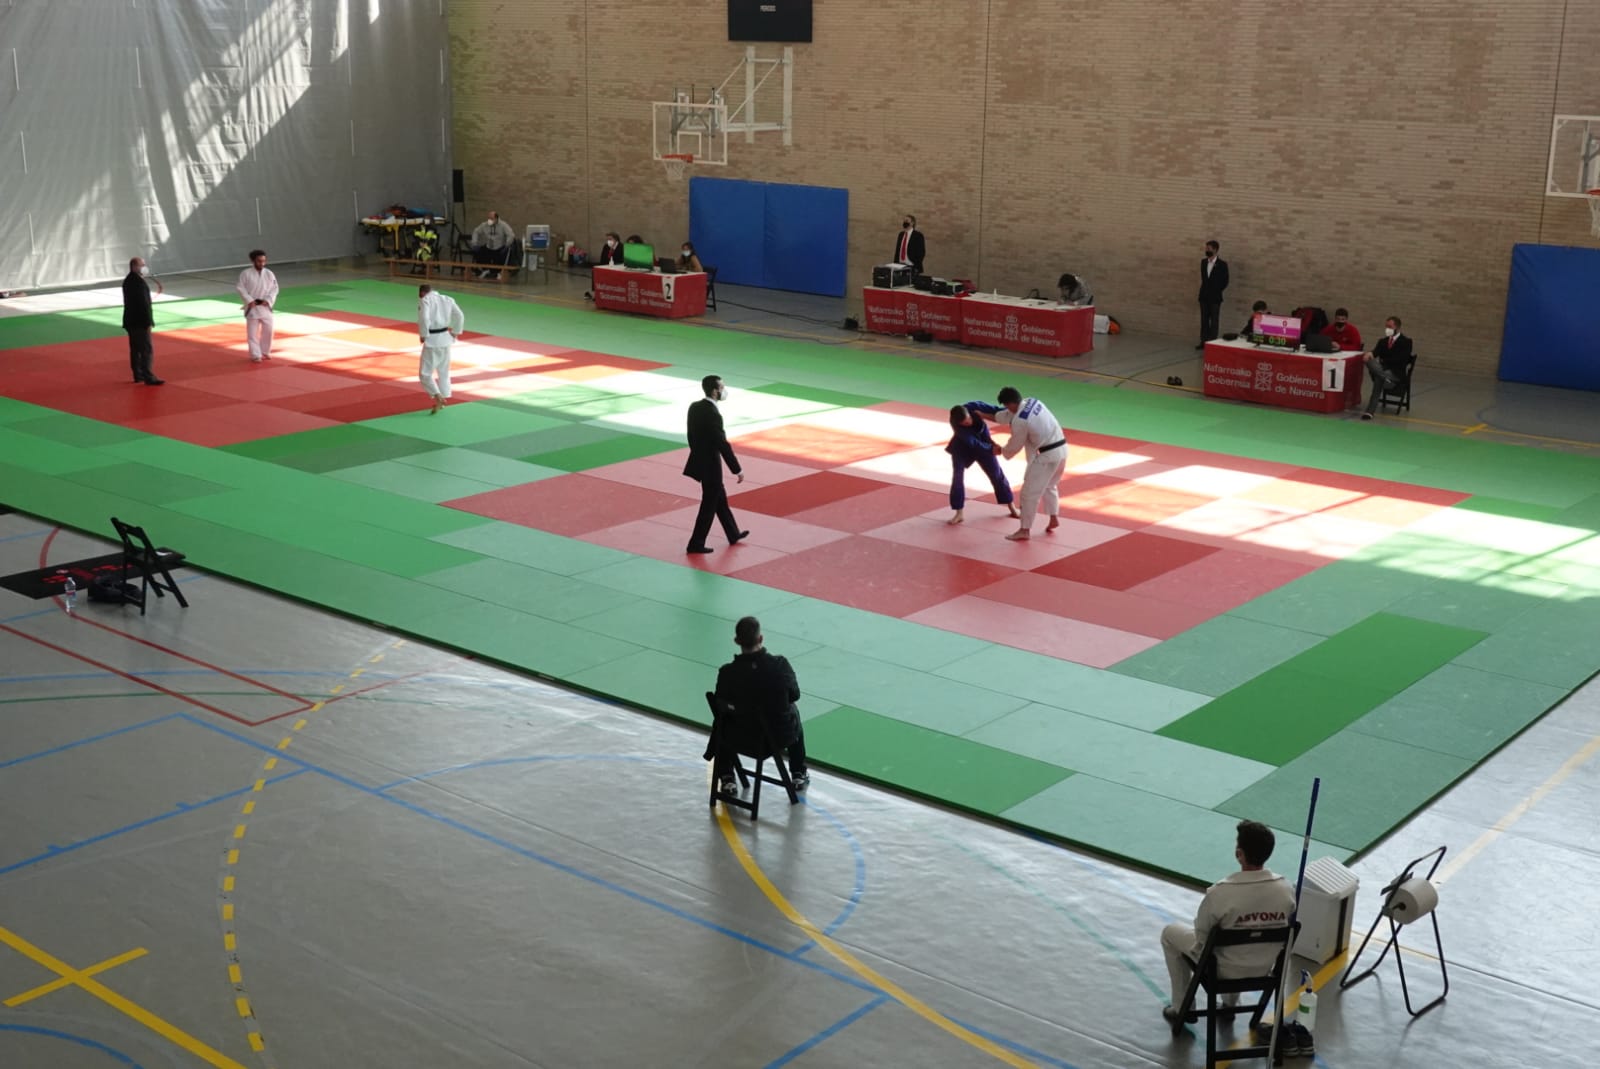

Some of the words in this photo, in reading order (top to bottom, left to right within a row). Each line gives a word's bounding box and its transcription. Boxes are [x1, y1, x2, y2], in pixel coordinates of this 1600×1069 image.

[665, 283, 672, 300] 2
[963, 317, 1002, 329] Nafarroako
[968, 327, 1002, 339] Gobernua
[1021, 324, 1055, 336] Gobierno
[1021, 334, 1031, 342] de
[1032, 335, 1061, 347] Navarra
[1204, 363, 1252, 377] Nafarroako
[1208, 375, 1251, 389] Gobernua
[1276, 373, 1318, 386] Gobierno
[1327, 367, 1337, 389] 1
[1275, 384, 1287, 393] de
[1289, 386, 1325, 399] Navarra
[1234, 911, 1286, 924] ASVONA
